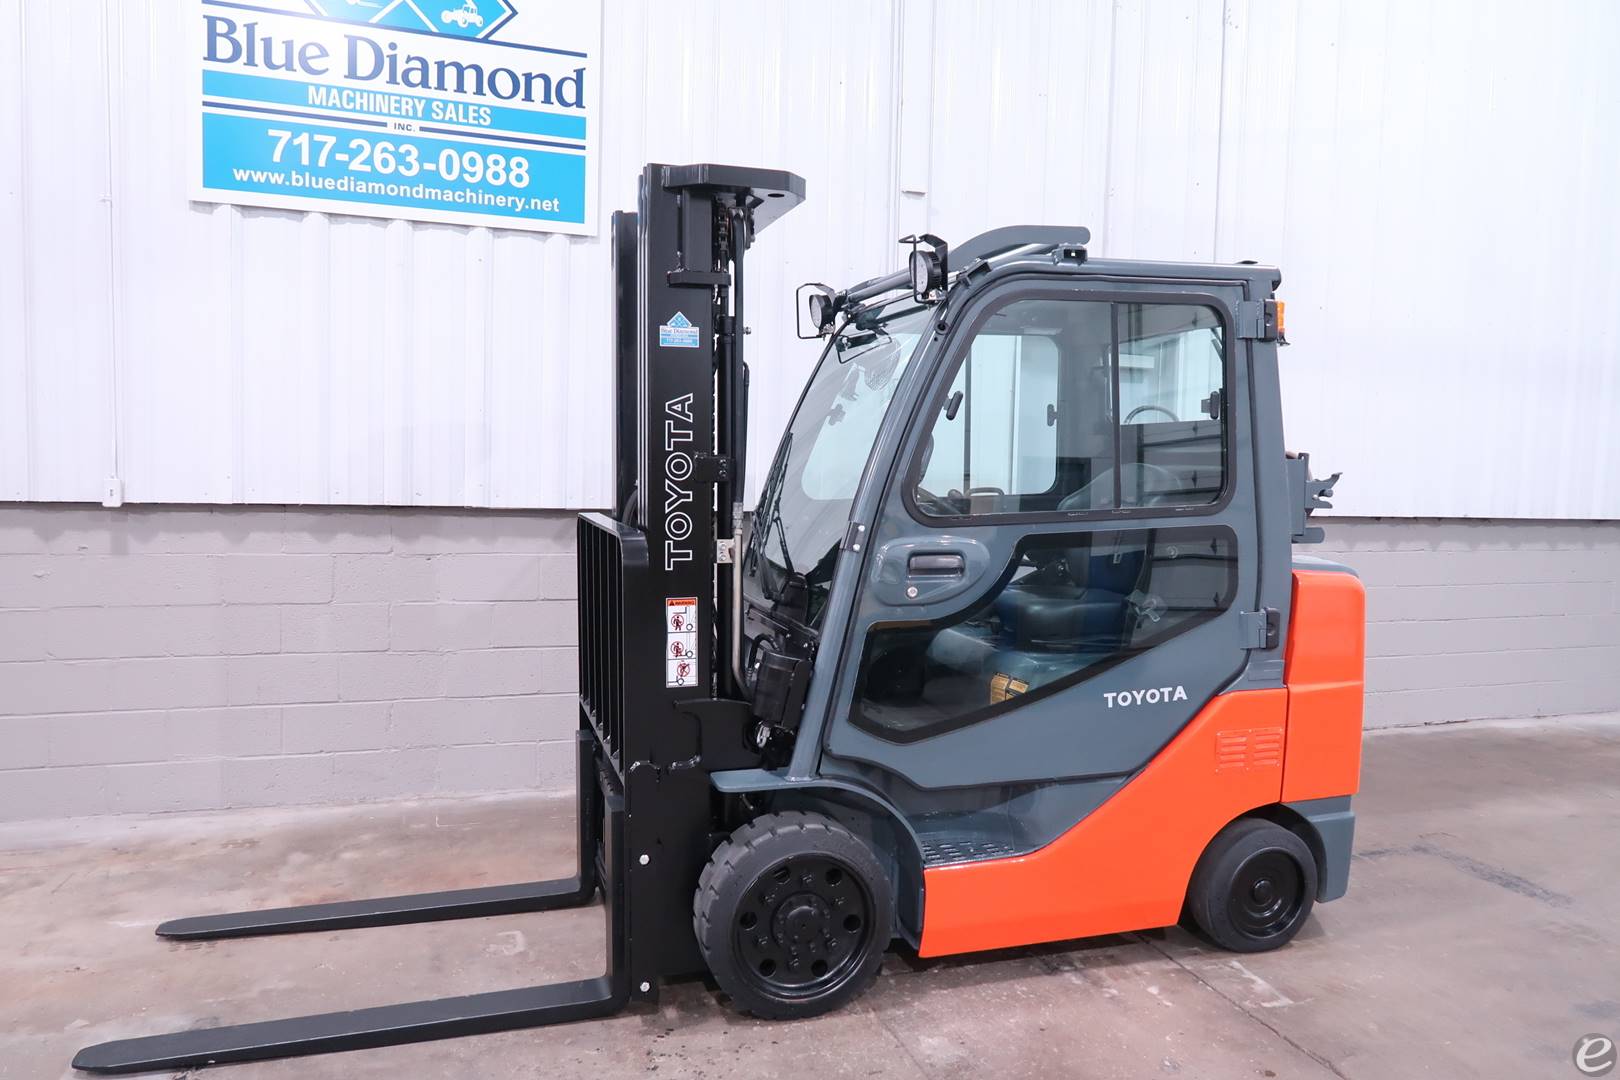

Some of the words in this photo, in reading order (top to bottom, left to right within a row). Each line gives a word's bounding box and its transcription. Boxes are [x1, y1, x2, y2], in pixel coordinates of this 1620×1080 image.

[202, 14, 329, 76] Blue
[343, 34, 586, 109] Diamond
[308, 85, 426, 118] MACHINERY
[431, 100, 492, 126] SALES
[393, 122, 416, 132] INC.
[267, 128, 530, 188] 717-263-0988
[232, 167, 560, 213] www.bluediamondmachinery.net
[665, 393, 694, 571] TOYOTA
[1103, 685, 1188, 708] TOYOTA
